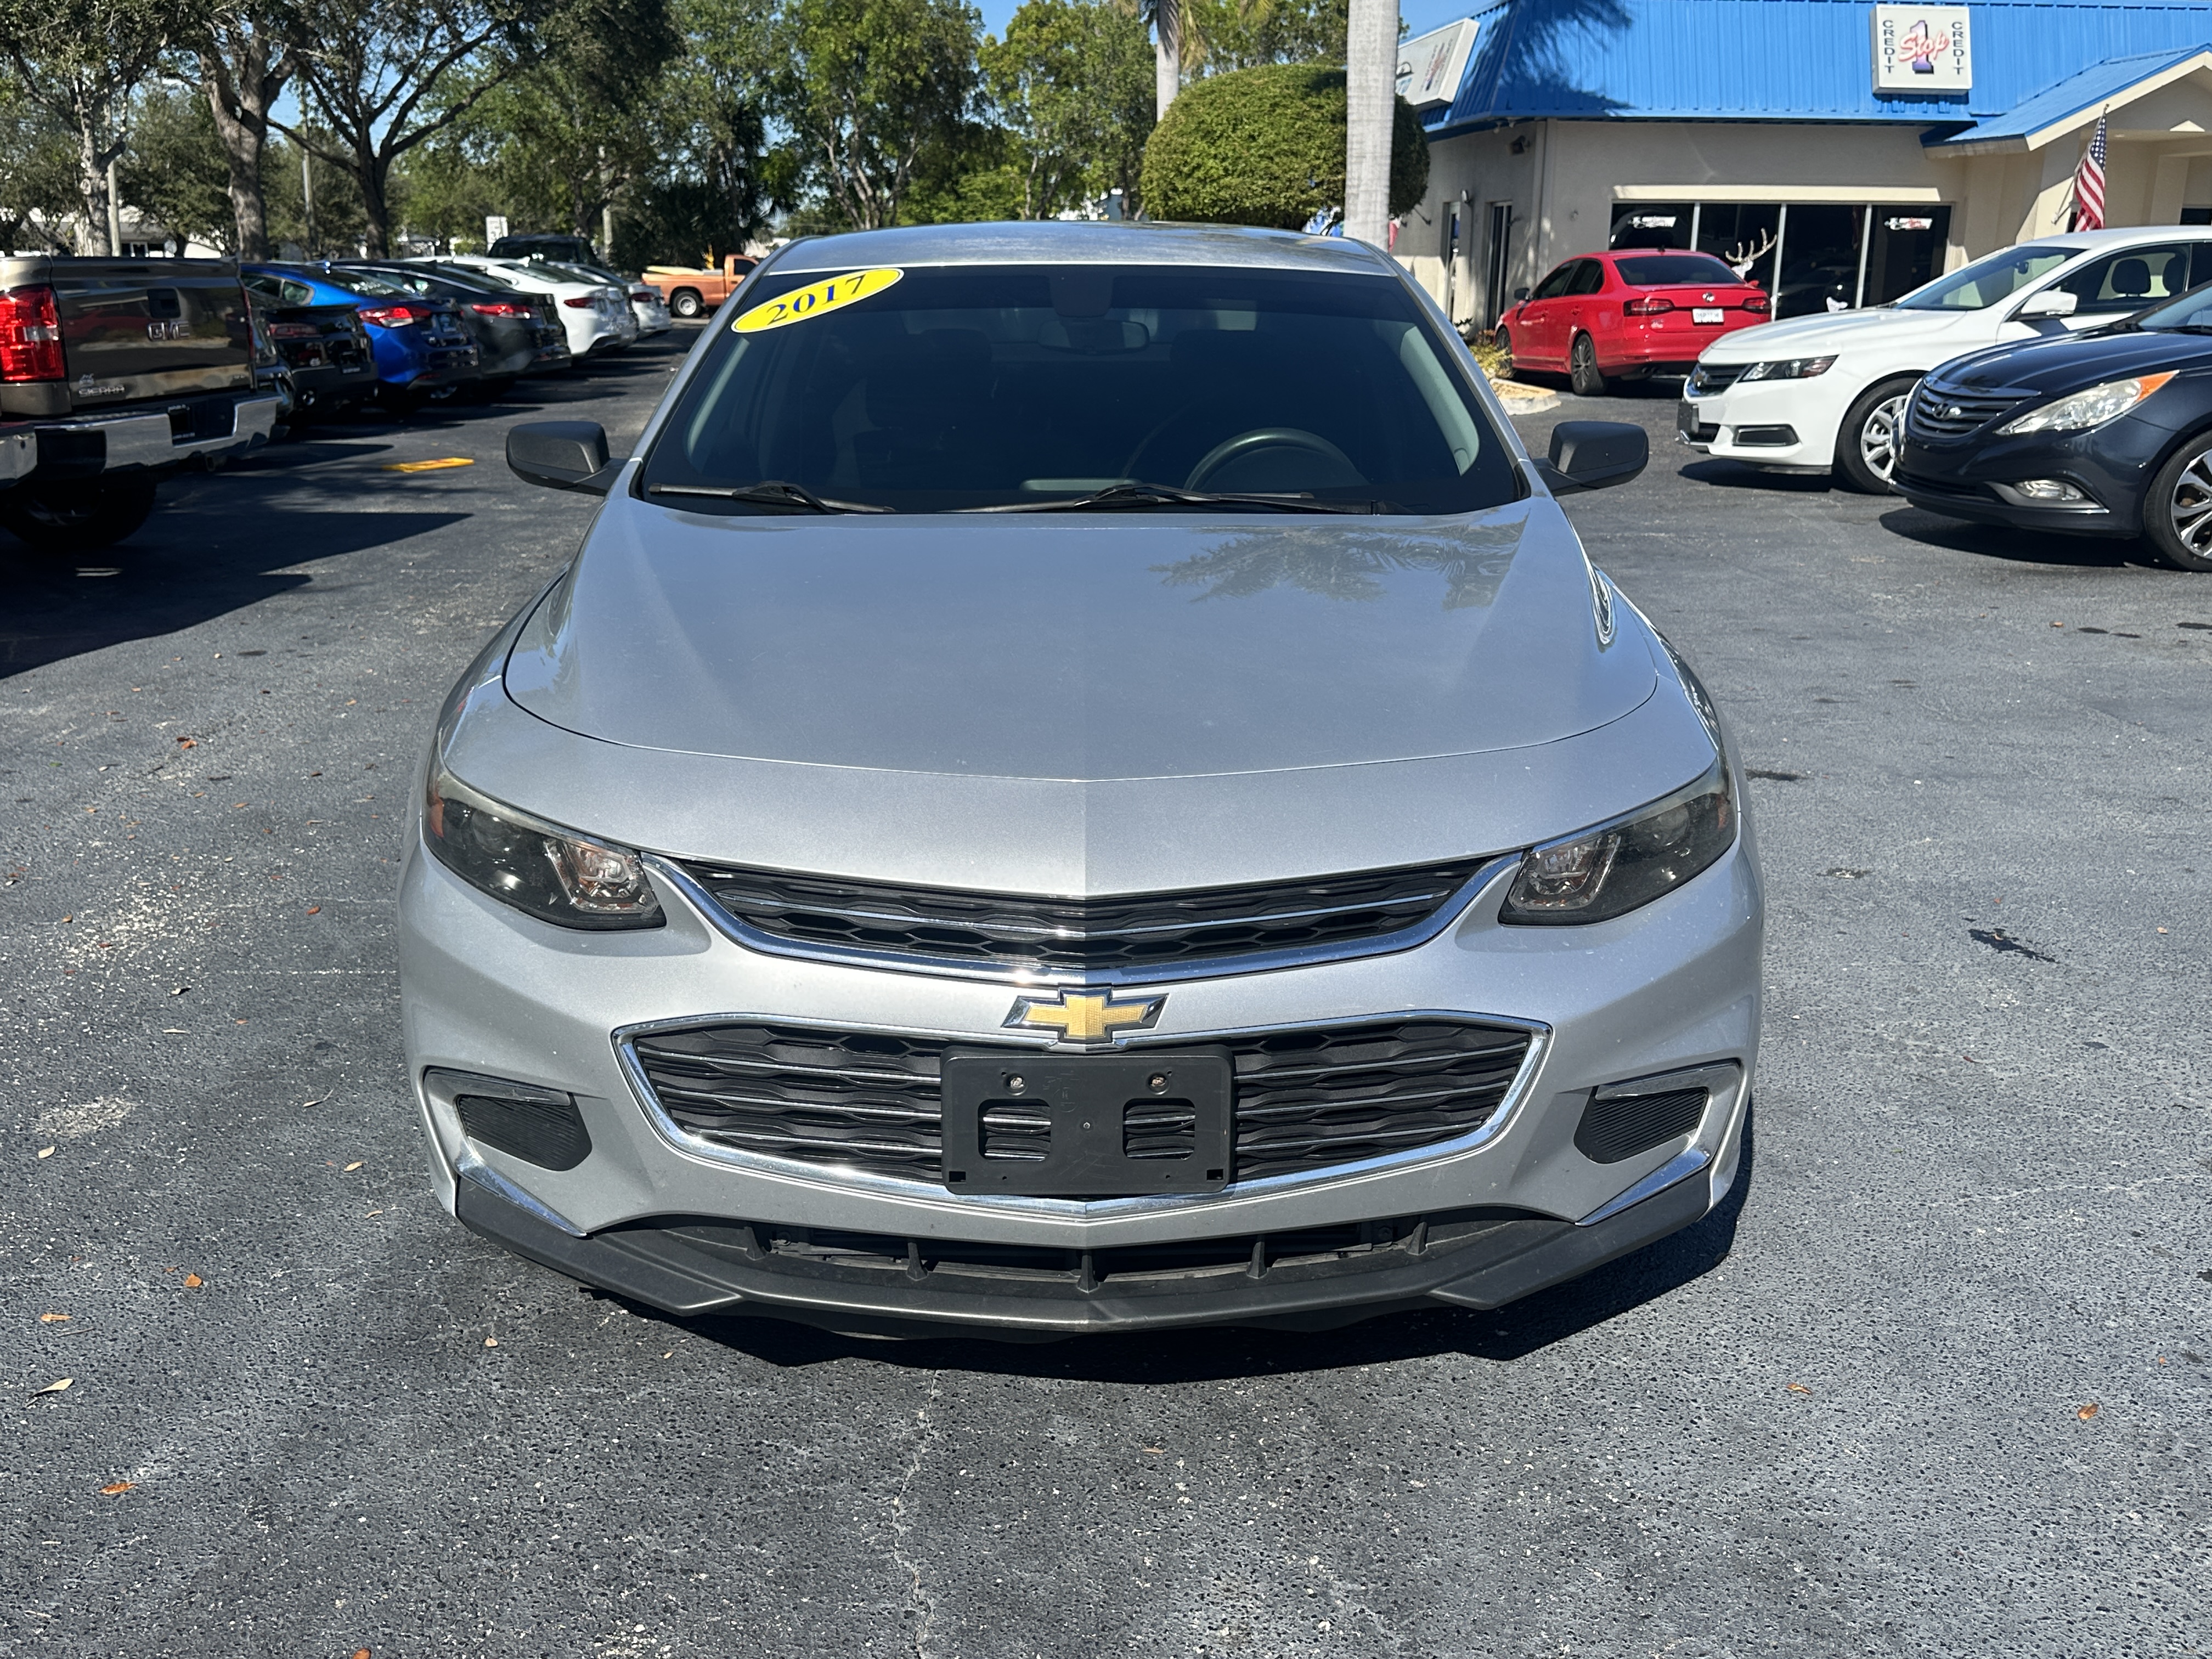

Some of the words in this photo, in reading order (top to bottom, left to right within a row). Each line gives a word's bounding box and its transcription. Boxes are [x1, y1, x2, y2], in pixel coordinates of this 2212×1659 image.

[1882, 20, 1895, 74] CREDIT
[1898, 31, 1950, 63] Stop
[1951, 21, 1965, 76] CREDIT
[766, 273, 866, 326] 2017
[148, 320, 190, 341] GMC
[78, 385, 125, 397] SIERRA
